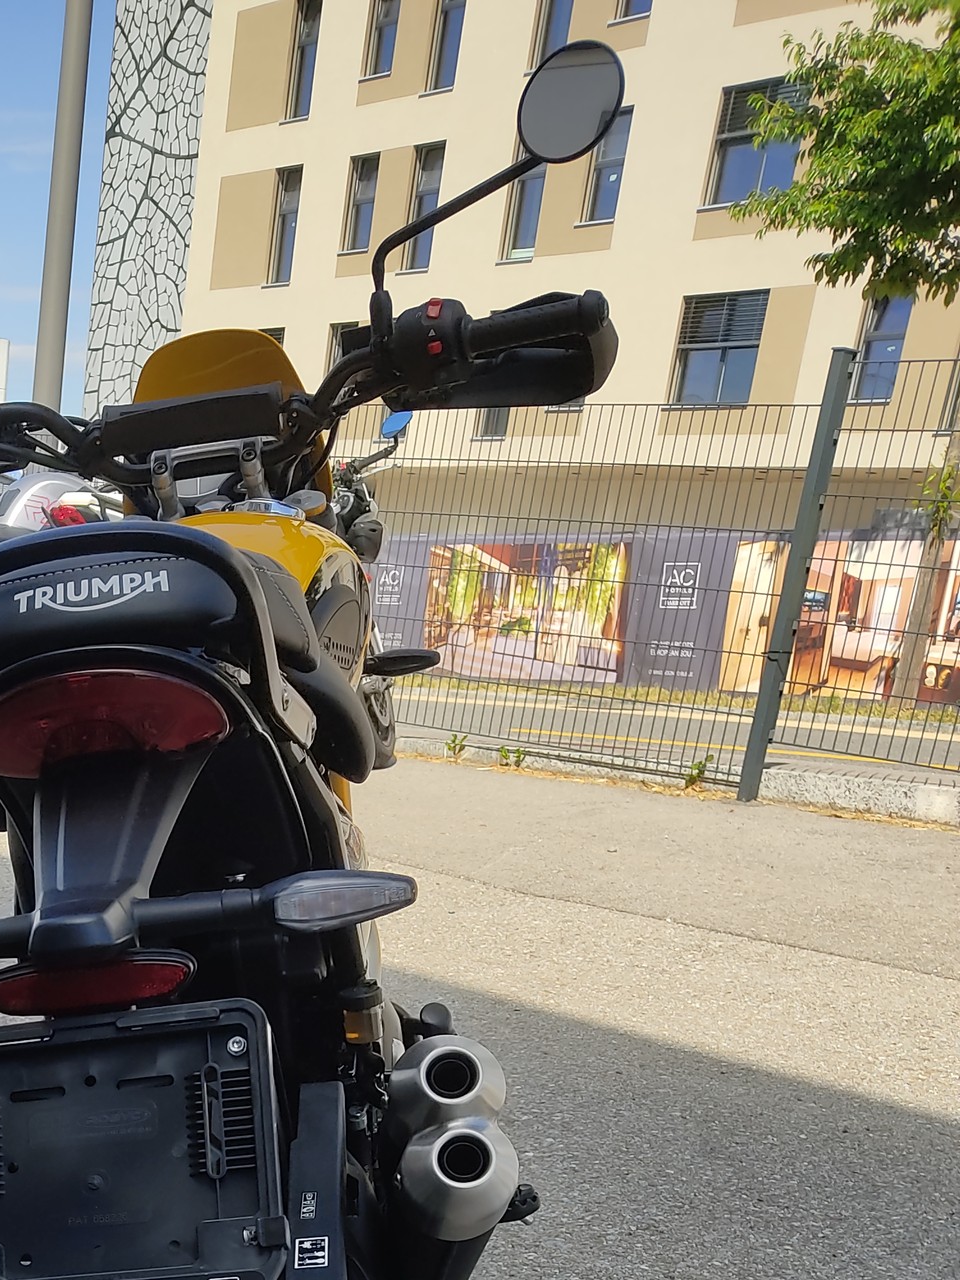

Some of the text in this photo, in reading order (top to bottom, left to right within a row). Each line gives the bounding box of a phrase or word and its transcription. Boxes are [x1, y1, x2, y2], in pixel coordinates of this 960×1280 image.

[379, 569, 399, 585] AC
[667, 568, 694, 586] AC
[13, 569, 170, 614] TRIUMPH
